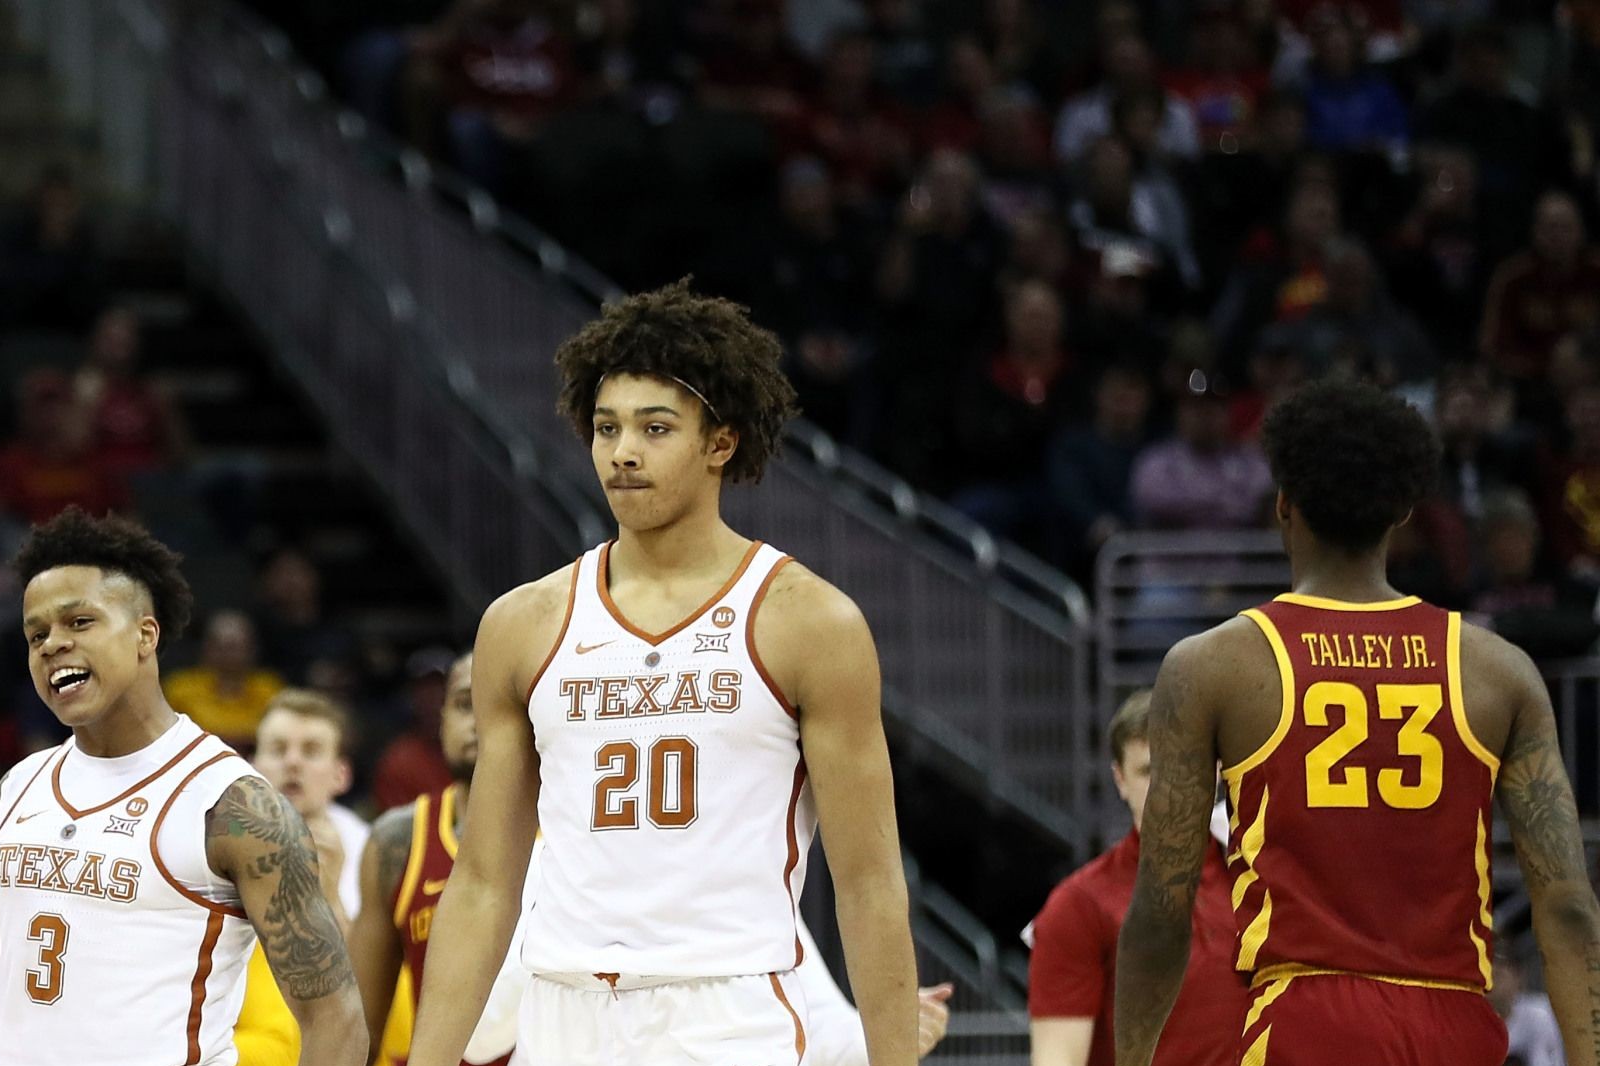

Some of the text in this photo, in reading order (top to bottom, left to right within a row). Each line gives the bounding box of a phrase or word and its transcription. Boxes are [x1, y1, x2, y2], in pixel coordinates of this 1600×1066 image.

[560, 669, 743, 722] TEXAS
[1301, 632, 1436, 669] TALLEY JR.
[590, 735, 699, 832] 20
[1303, 681, 1444, 809] 23
[24, 911, 71, 1006] 3
